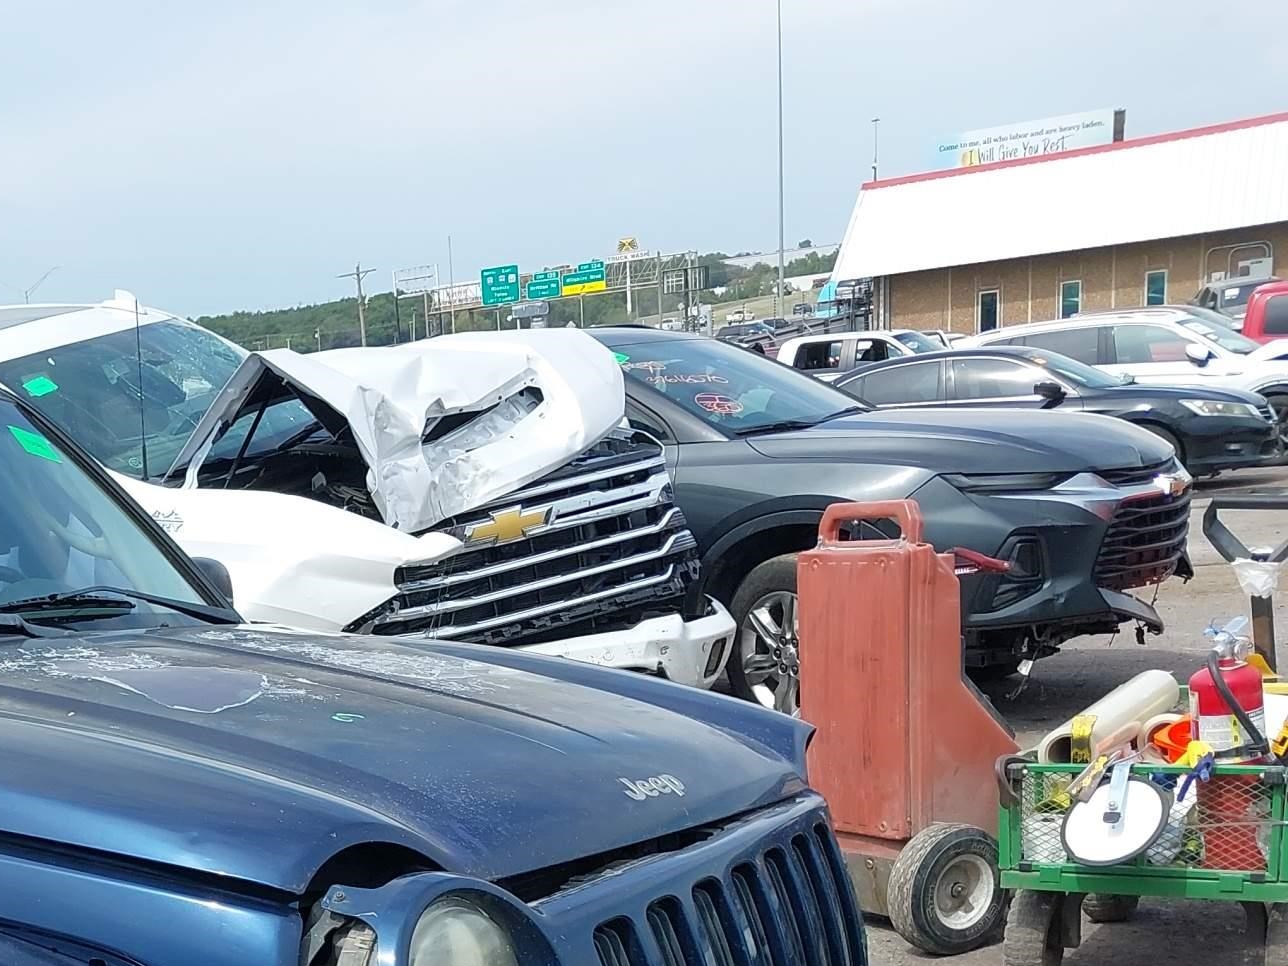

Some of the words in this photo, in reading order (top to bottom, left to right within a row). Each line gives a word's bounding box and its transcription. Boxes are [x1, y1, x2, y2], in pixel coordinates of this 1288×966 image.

[939, 143, 959, 153] Come
[982, 137, 992, 145] all
[993, 135, 1010, 143] who
[1009, 131, 1029, 141] labor
[1030, 129, 1044, 138] and
[1059, 124, 1080, 133] heavy
[969, 150, 974, 165] I
[978, 147, 995, 164] Will
[998, 145, 1018, 162] Give
[1022, 141, 1039, 157] You
[631, 250, 650, 259] WASH
[616, 773, 686, 801] Jeep
